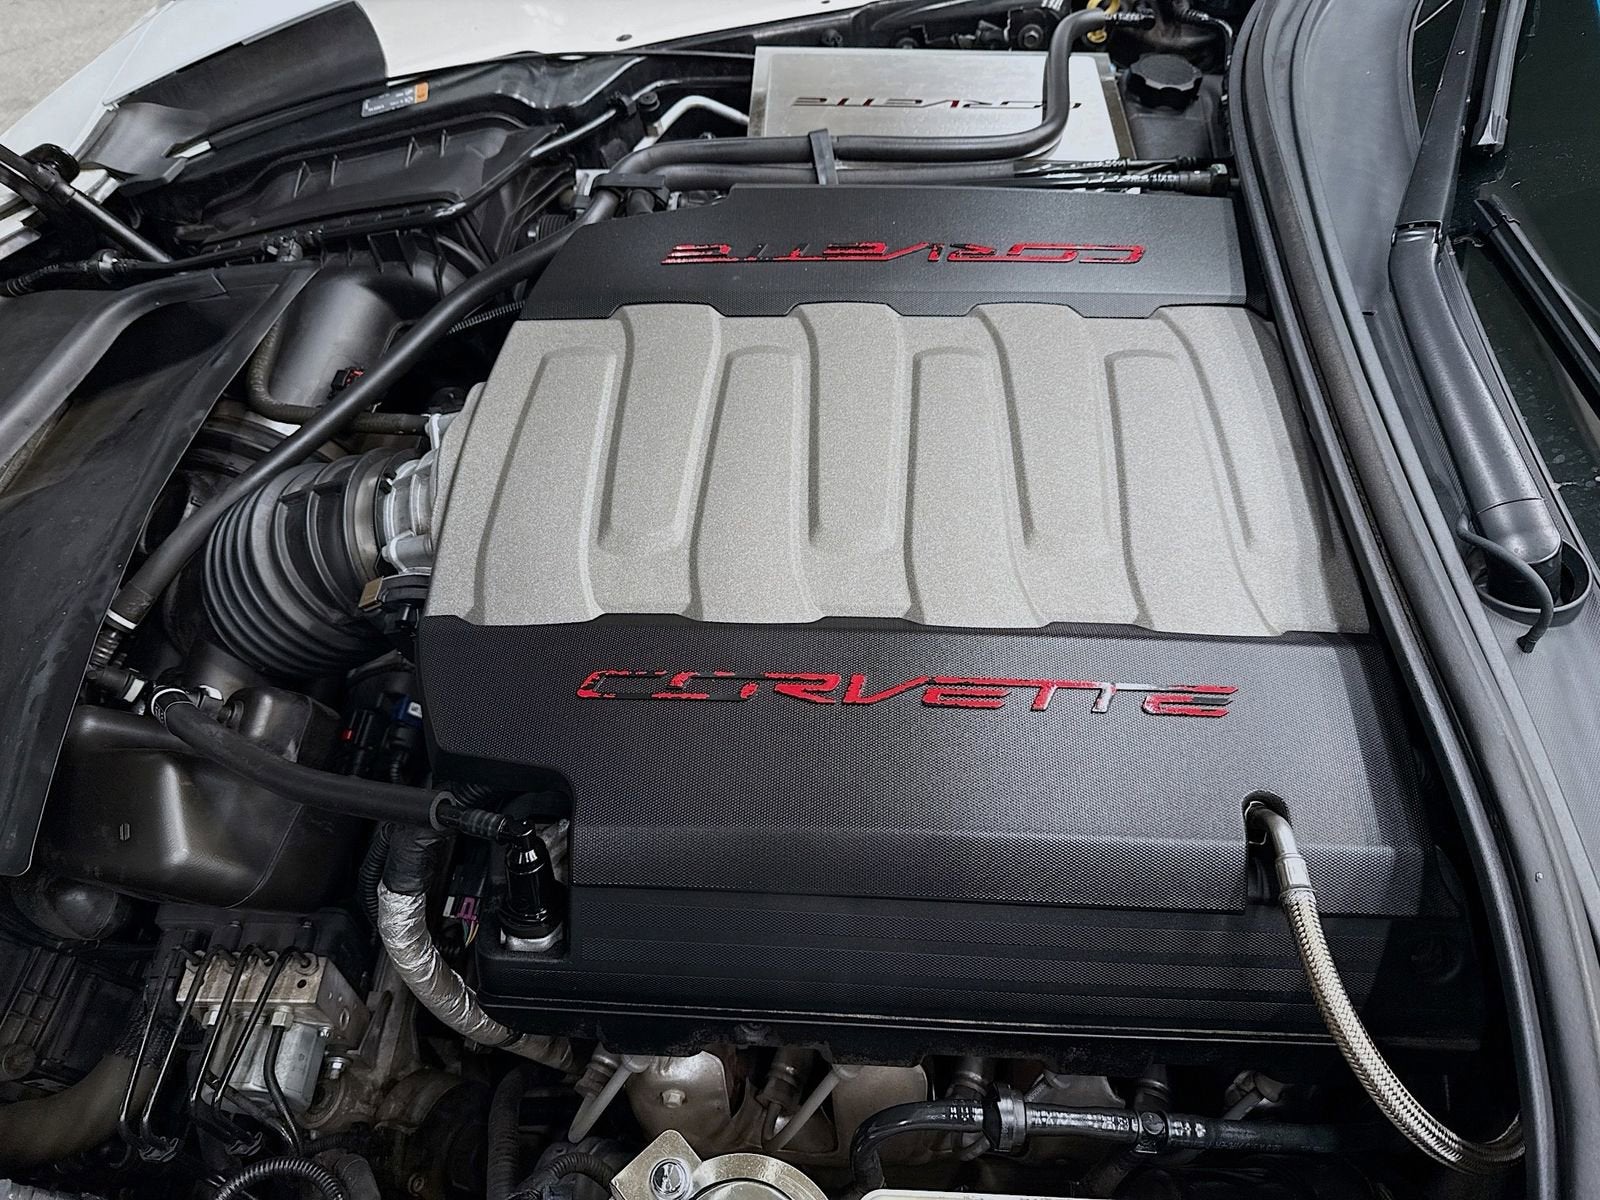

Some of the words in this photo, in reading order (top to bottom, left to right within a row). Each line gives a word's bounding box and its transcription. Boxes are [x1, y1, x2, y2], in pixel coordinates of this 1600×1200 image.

[791, 97, 1082, 109] ORVETTE
[660, 241, 1147, 265] CORVETTE
[577, 669, 1239, 717] CORVETTE
